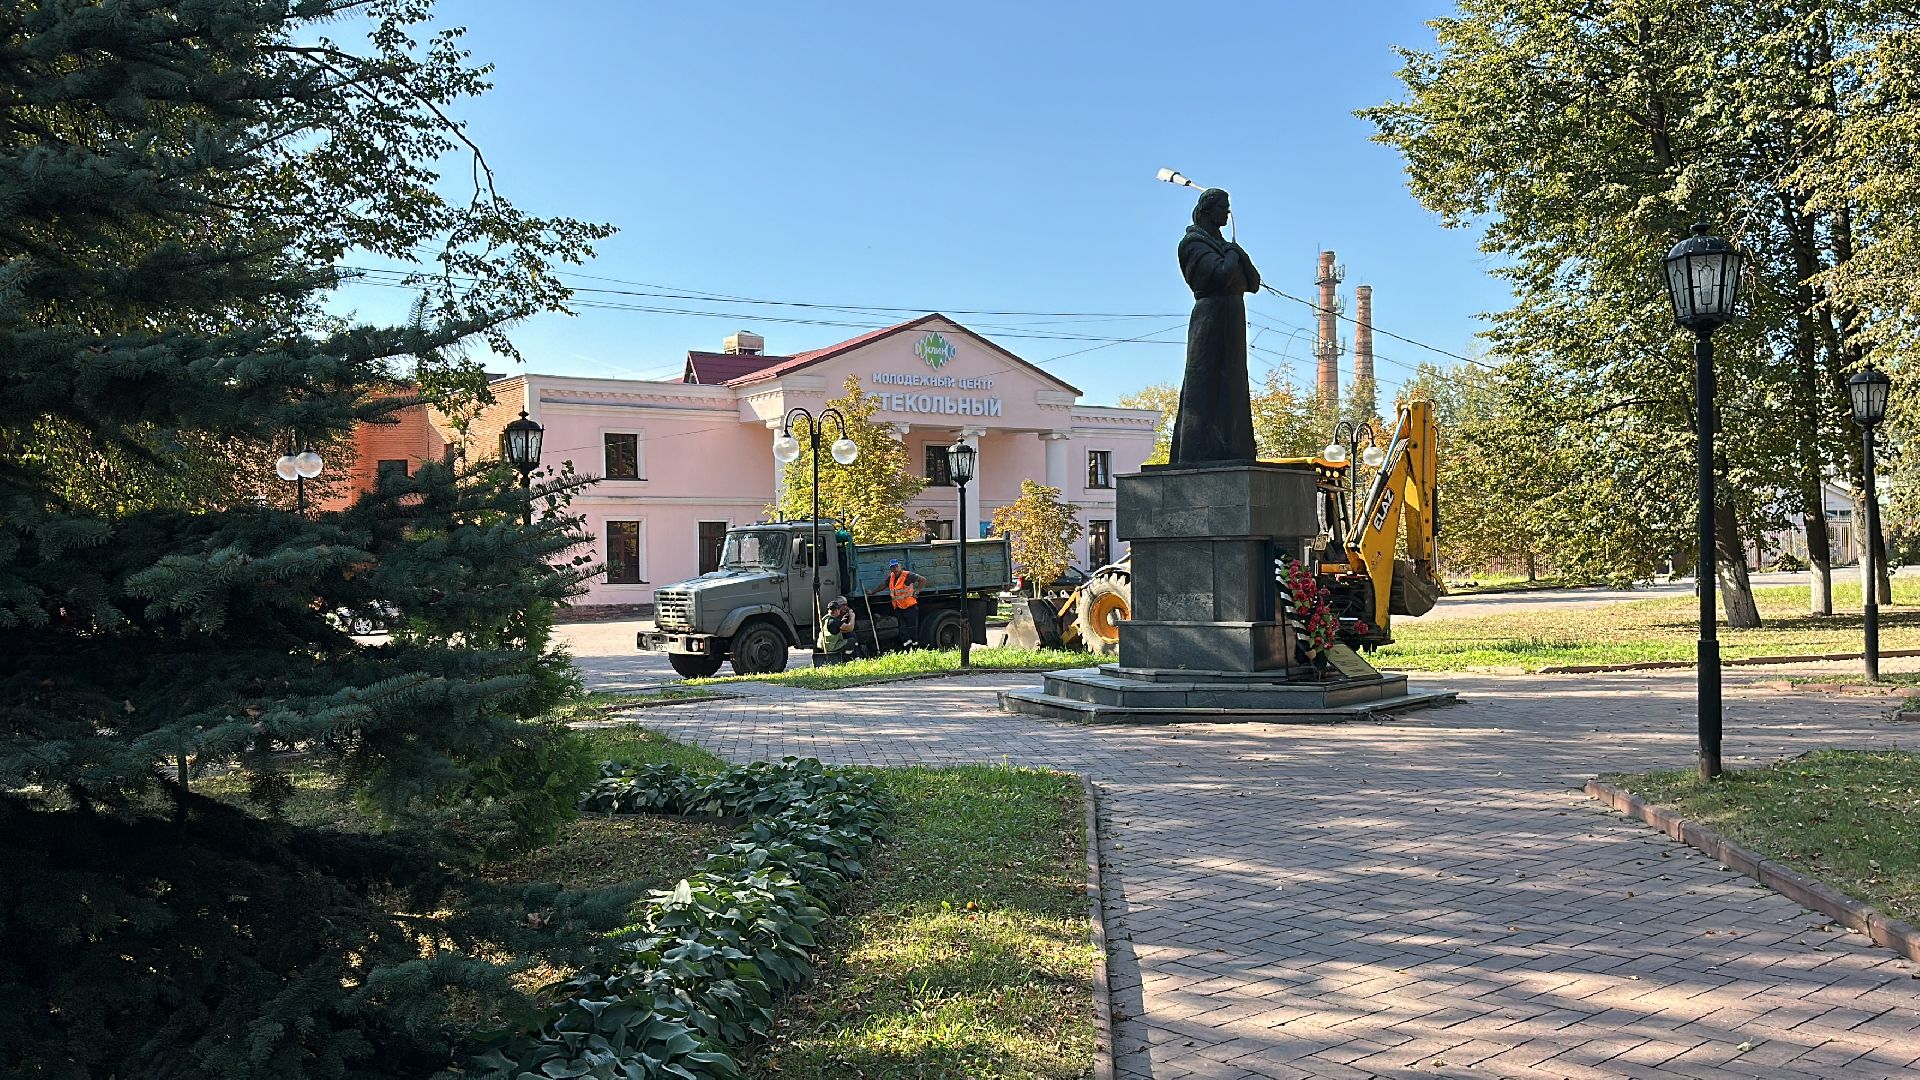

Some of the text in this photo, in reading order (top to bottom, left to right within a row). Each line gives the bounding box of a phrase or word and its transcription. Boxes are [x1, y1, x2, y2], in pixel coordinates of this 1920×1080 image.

[872, 372, 994, 390] МОЛОДЕЖНЫЙ ЦЕНТР
[1373, 489, 1394, 530] ELAZ
